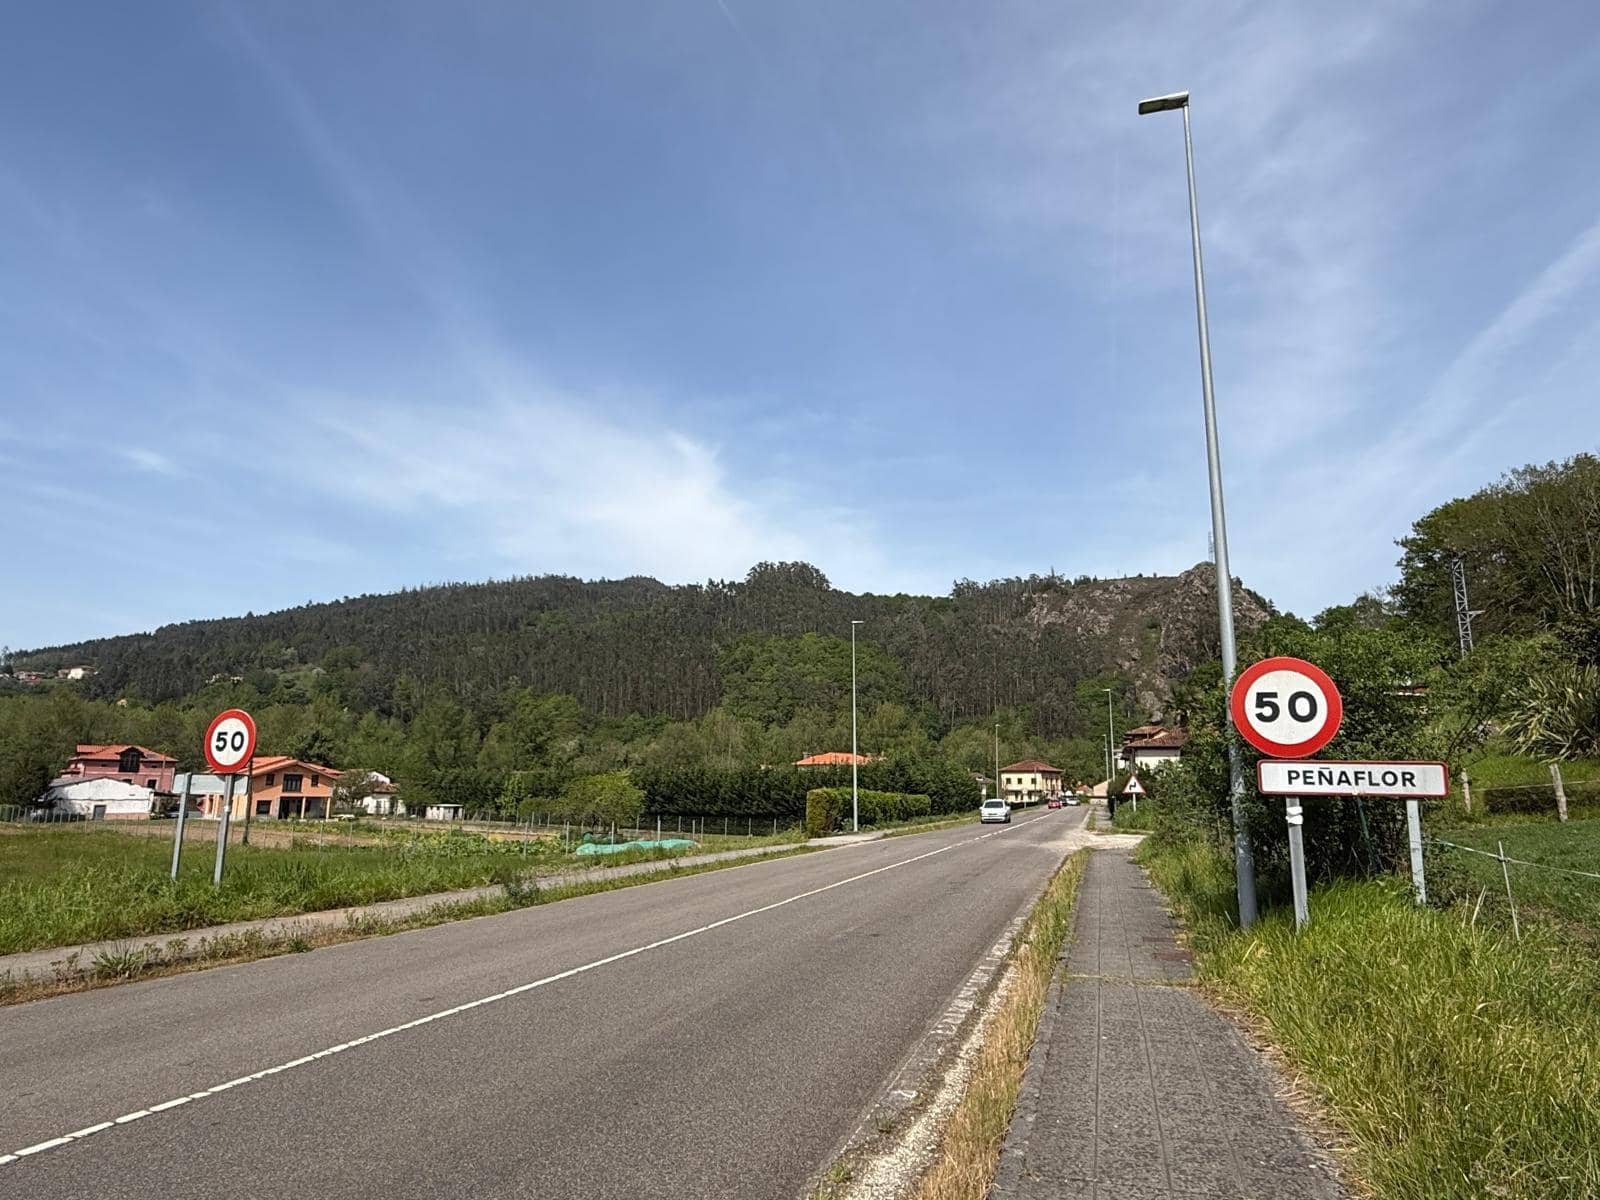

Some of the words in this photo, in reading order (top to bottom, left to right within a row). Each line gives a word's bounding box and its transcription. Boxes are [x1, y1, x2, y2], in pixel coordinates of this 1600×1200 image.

[1255, 691, 1318, 723] 50
[215, 731, 245, 752] 50
[1287, 767, 1417, 788] PEÑAFLOR
